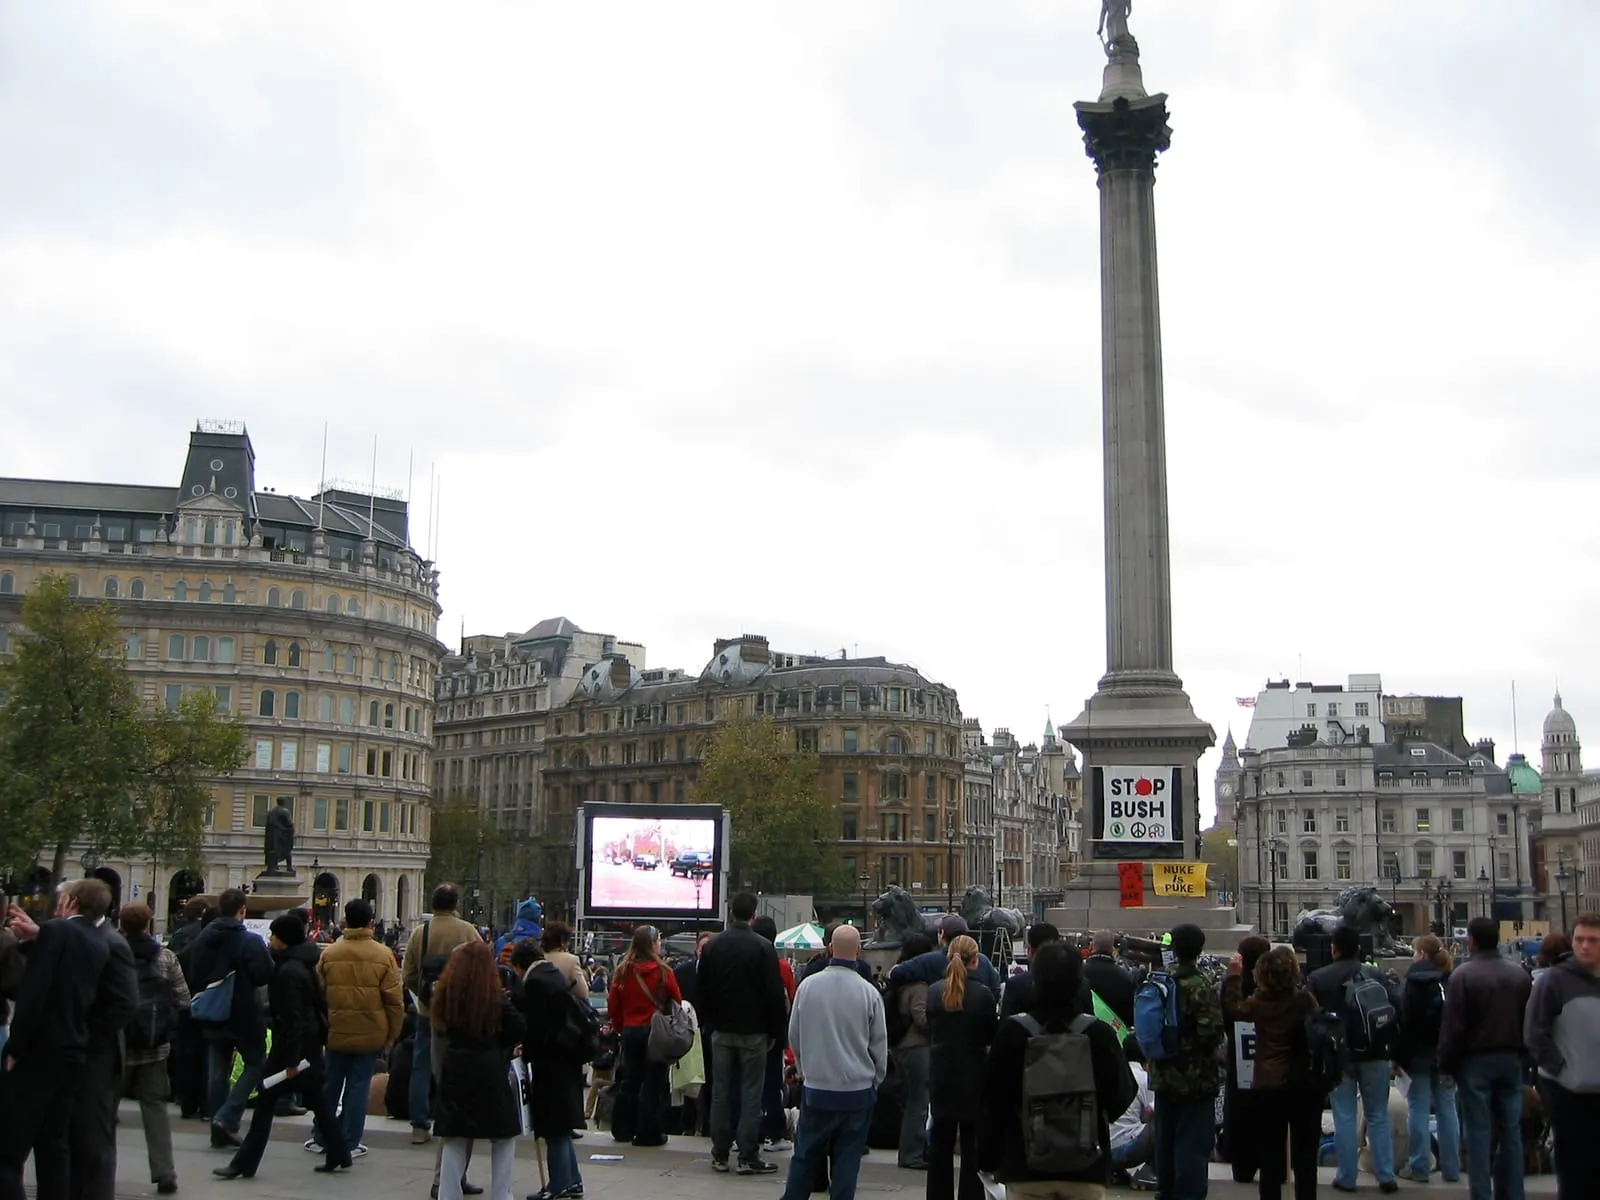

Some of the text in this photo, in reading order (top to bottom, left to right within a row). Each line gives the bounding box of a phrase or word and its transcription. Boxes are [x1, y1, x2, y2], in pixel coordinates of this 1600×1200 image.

[1110, 776, 1165, 796] STOP
[1110, 800, 1164, 818] BUSH
[1163, 865, 1194, 874] NUKE
[1165, 883, 1194, 893] PUKE
